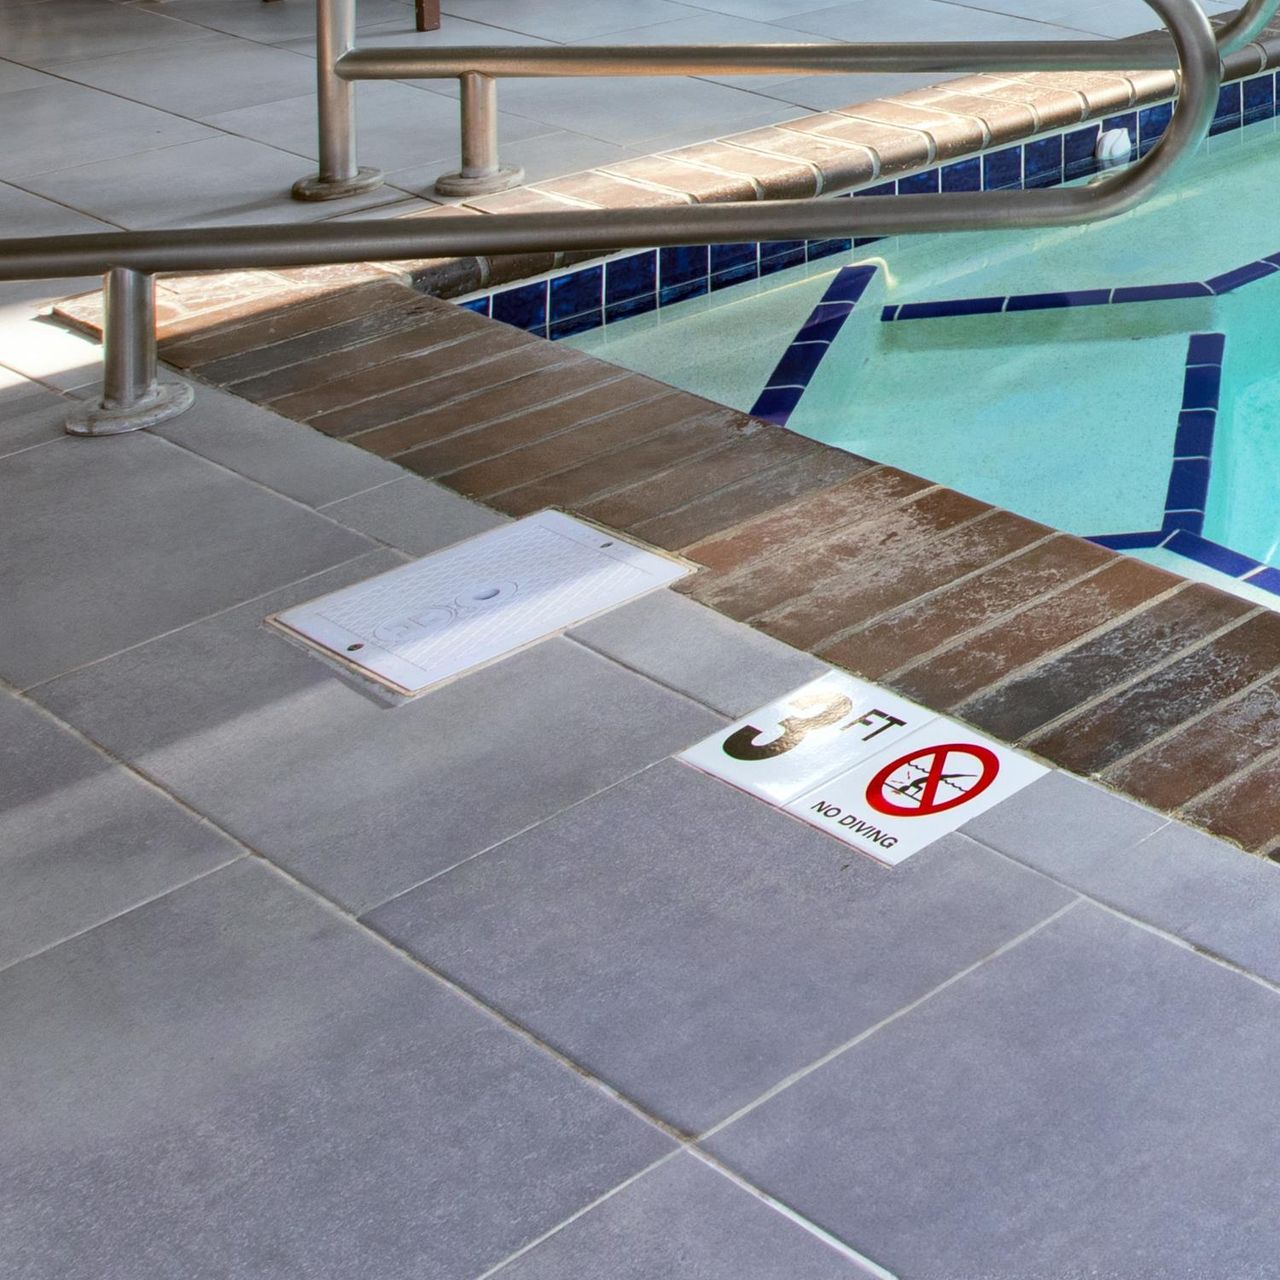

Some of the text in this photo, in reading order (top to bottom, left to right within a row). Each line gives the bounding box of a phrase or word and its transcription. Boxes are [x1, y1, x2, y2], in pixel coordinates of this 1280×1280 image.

[723, 692, 907, 761] 3 FT
[810, 800, 899, 849] NO DIVING
